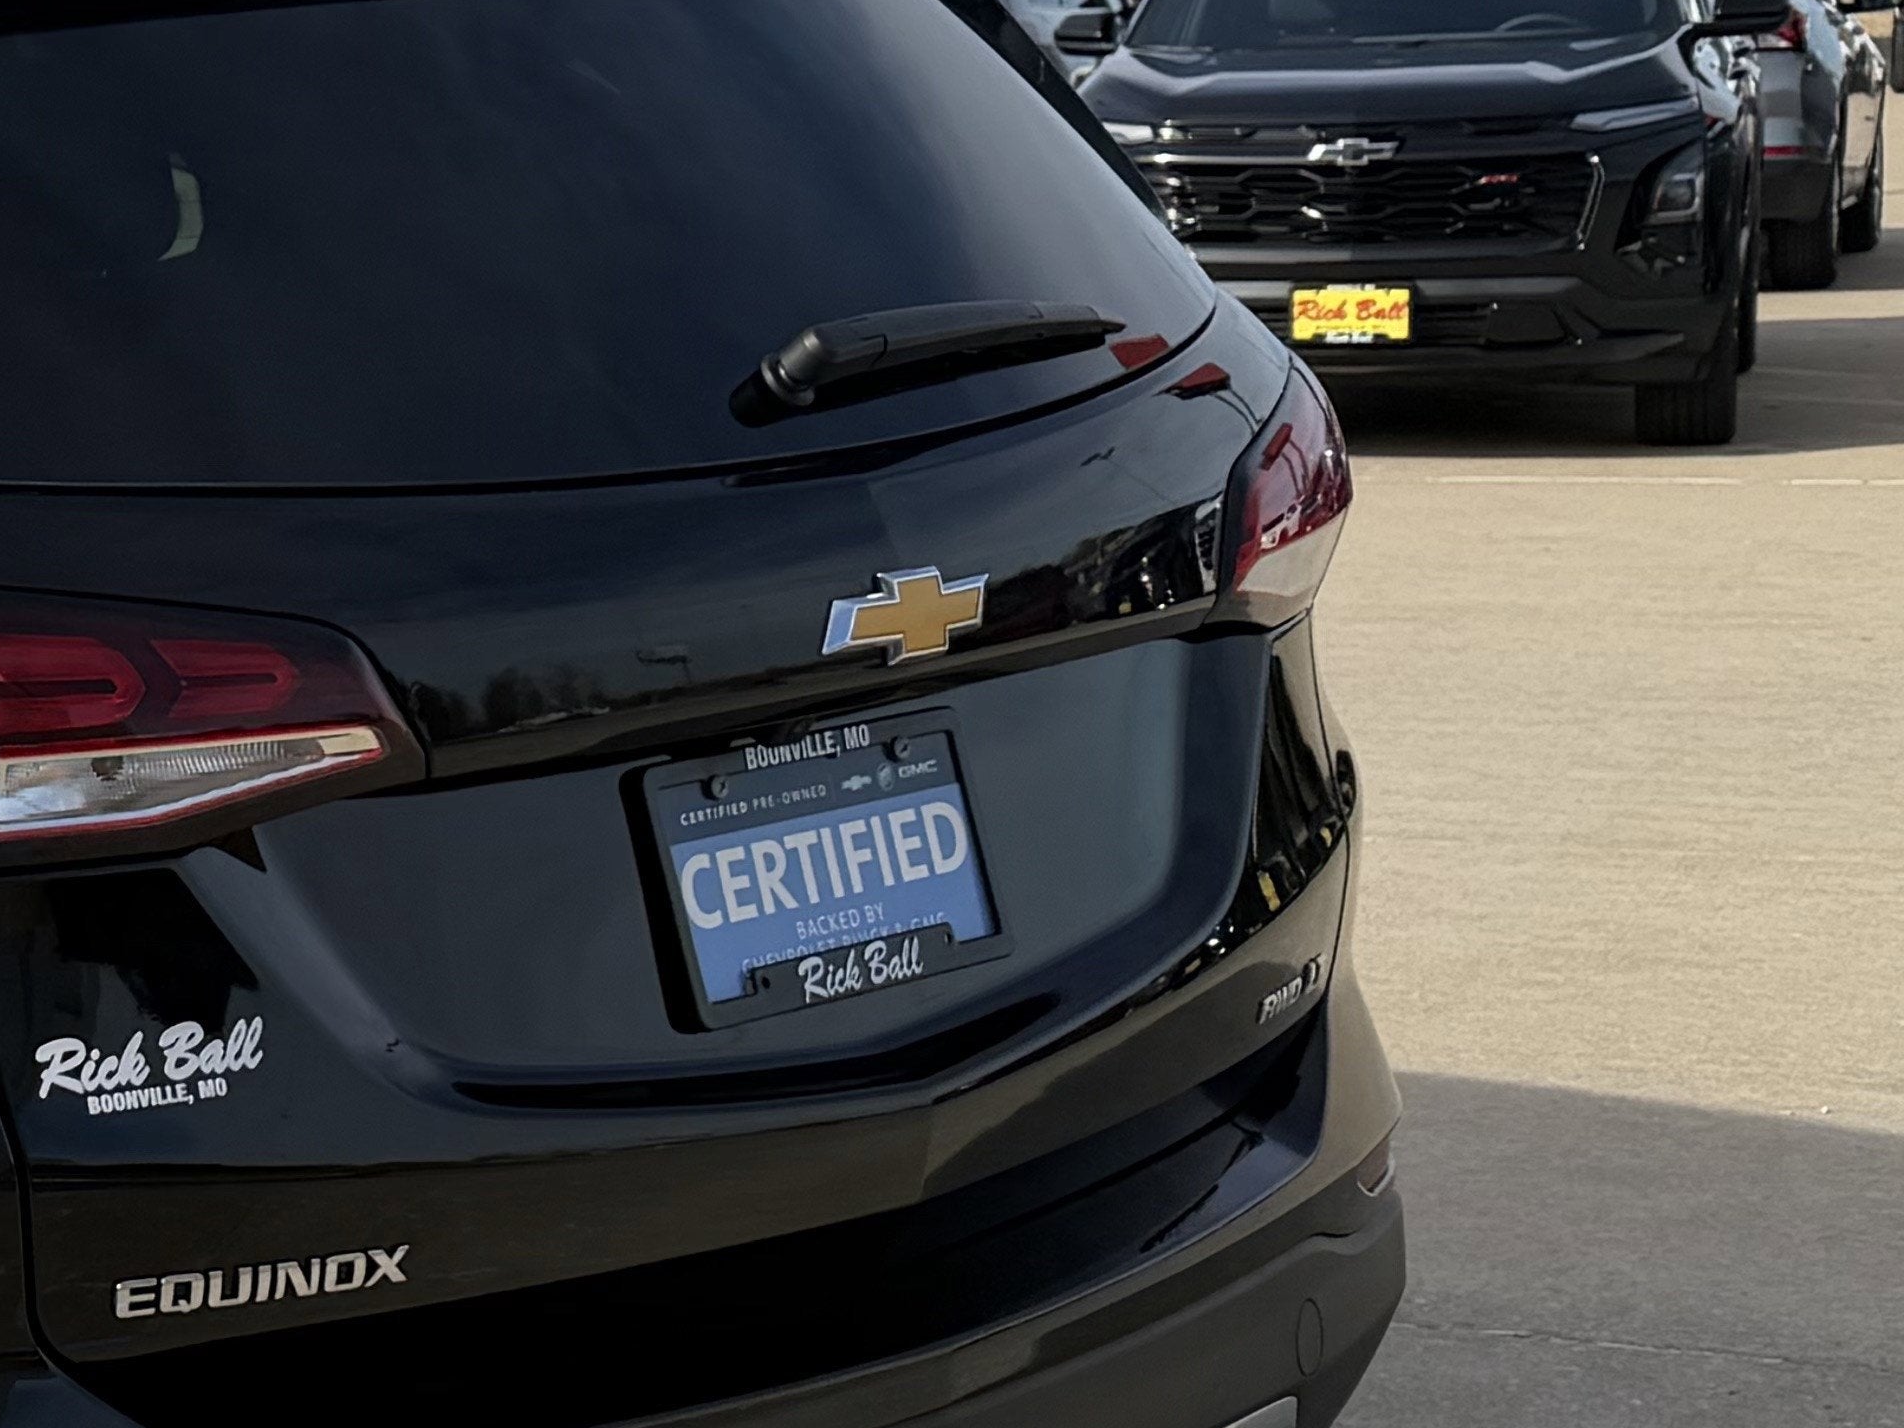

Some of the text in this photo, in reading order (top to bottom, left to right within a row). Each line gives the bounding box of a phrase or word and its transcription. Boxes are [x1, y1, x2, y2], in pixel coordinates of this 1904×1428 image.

[1294, 299, 1409, 320] Rick Ball
[843, 724, 870, 750] MO
[898, 760, 938, 778] GMC
[680, 784, 827, 826] CERTIFIED PRE-OWNED
[681, 802, 969, 929] CERTIFIED
[796, 903, 885, 940] BACKED BY
[798, 936, 924, 1003] Rick Ball
[35, 1016, 264, 1100] Rick Ball
[87, 1077, 228, 1115] BOONVILLE, MO
[115, 1244, 410, 1319] EQUINOX
